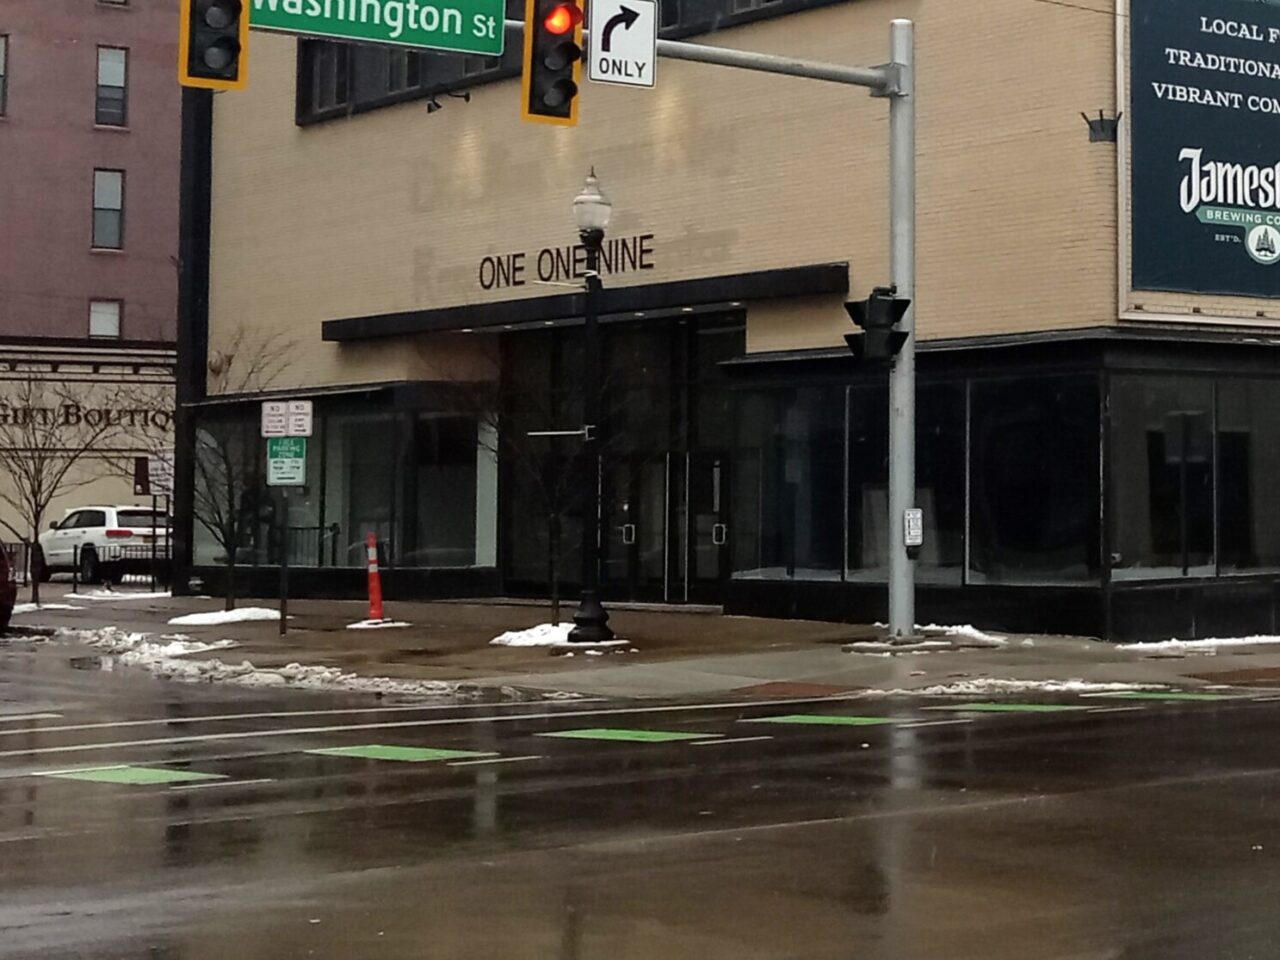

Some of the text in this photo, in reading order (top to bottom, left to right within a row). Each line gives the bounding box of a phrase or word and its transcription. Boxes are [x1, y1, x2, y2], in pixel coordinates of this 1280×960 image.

[473, 13, 497, 39] St
[1200, 17, 1263, 41] LOCAL
[599, 56, 648, 79] ONLY
[1152, 82, 1243, 109] VIBRANT
[1206, 210, 1262, 224] BREWING
[479, 234, 656, 290] ONE ONE NINE
[60, 403, 176, 432] BOUTIQ
